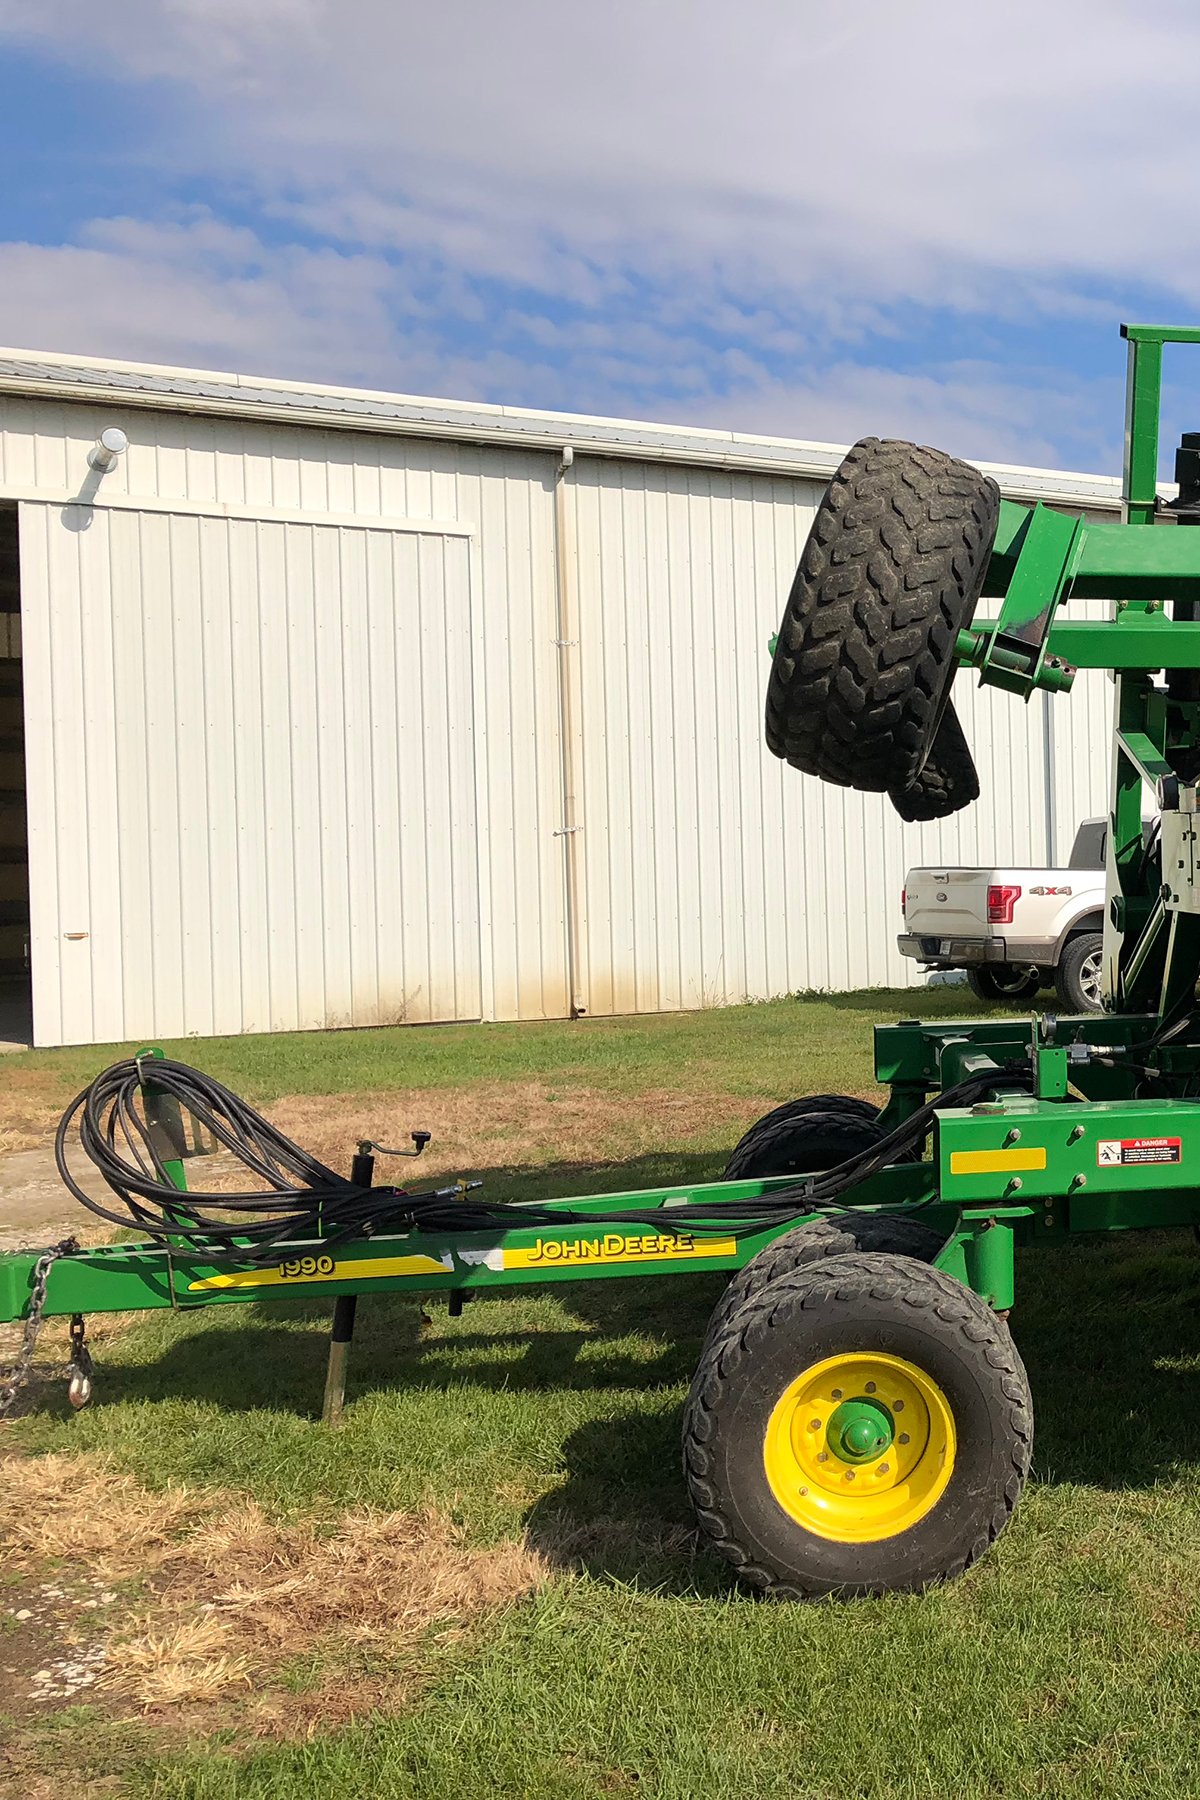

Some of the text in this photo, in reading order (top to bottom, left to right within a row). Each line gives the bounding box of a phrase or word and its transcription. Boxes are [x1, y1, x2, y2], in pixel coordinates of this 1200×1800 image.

[1141, 1139, 1168, 1147] DANGER
[527, 1233, 694, 1261] JOHN DEERE
[279, 1255, 335, 1277] 1990
